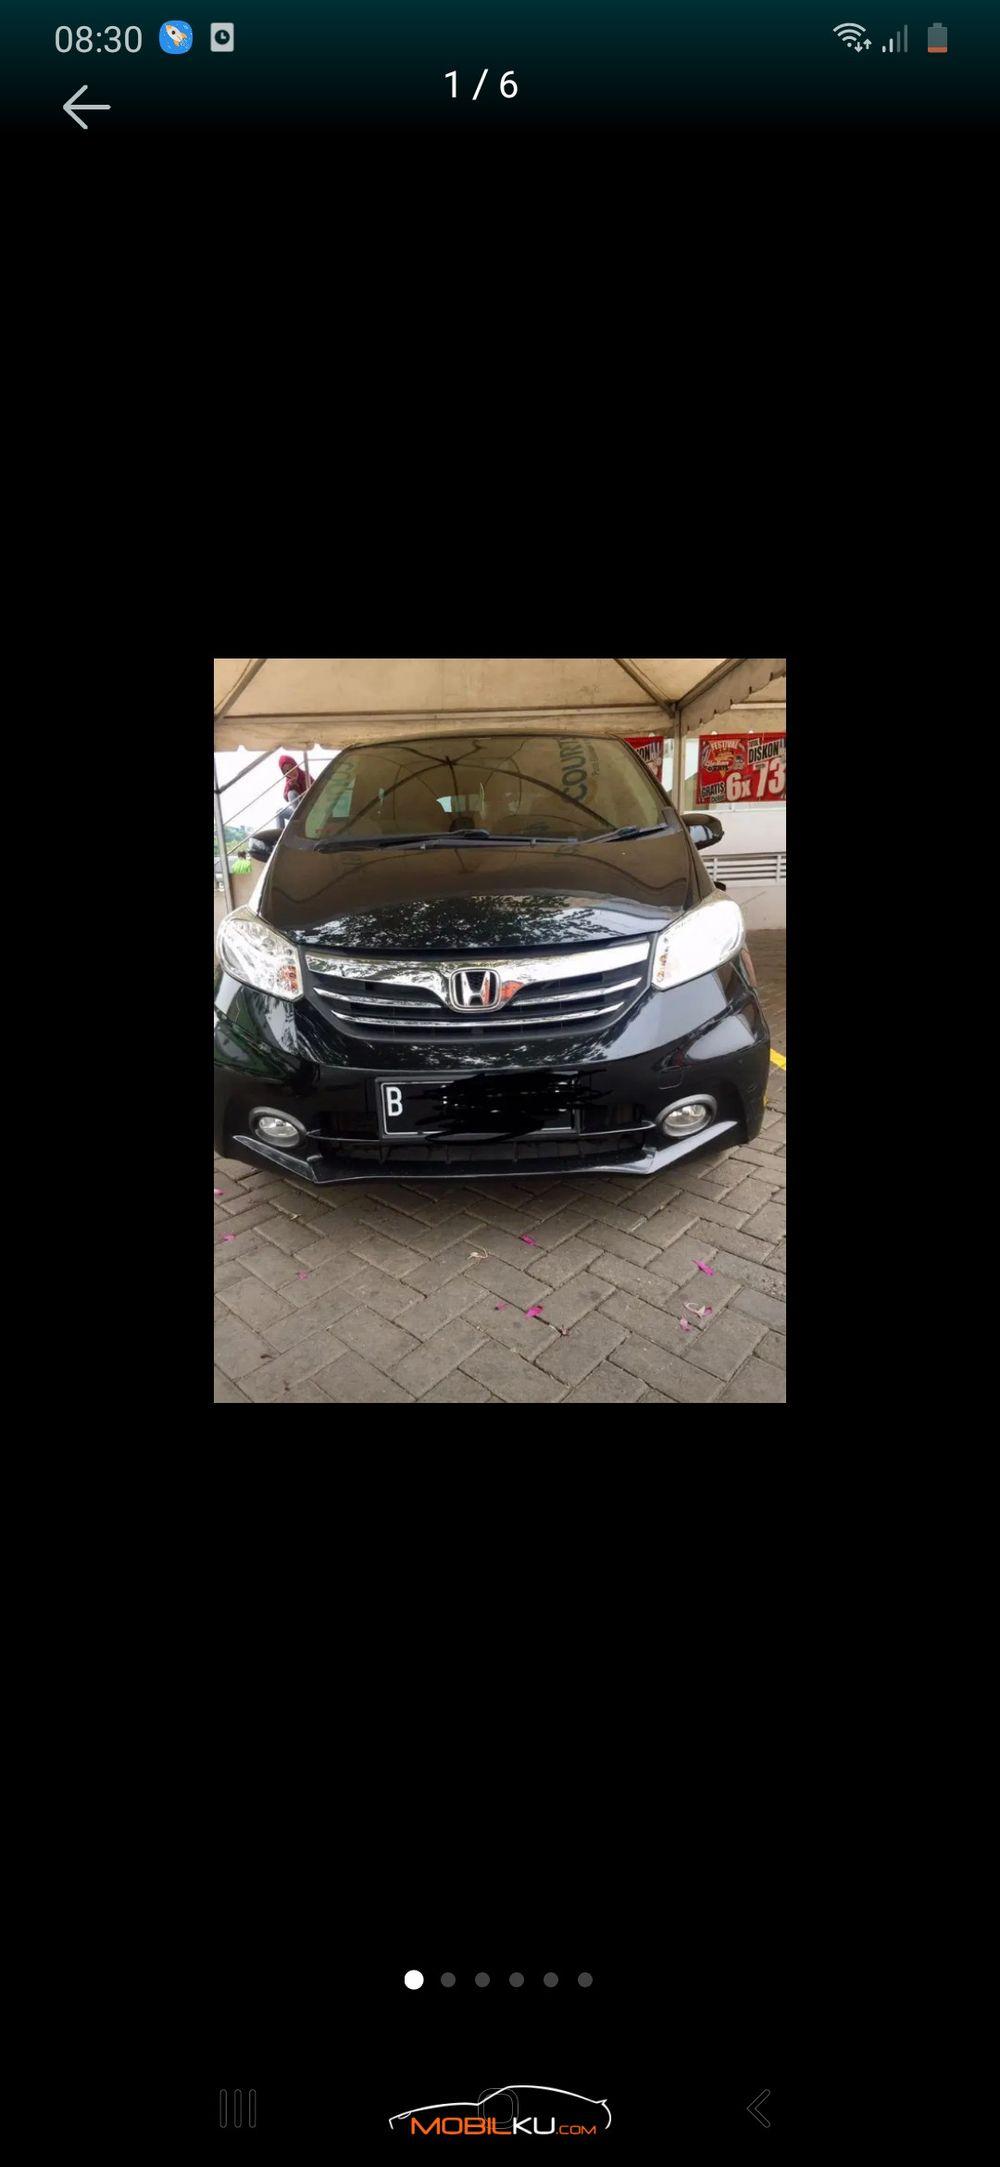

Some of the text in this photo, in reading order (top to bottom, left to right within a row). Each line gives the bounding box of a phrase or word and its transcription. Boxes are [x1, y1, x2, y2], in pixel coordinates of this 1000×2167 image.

[54, 25, 143, 53] 08:30
[444, 70, 458, 99] 1
[499, 70, 519, 99] 6
[748, 742, 779, 763] DISKON
[386, 1086, 404, 1117] B
